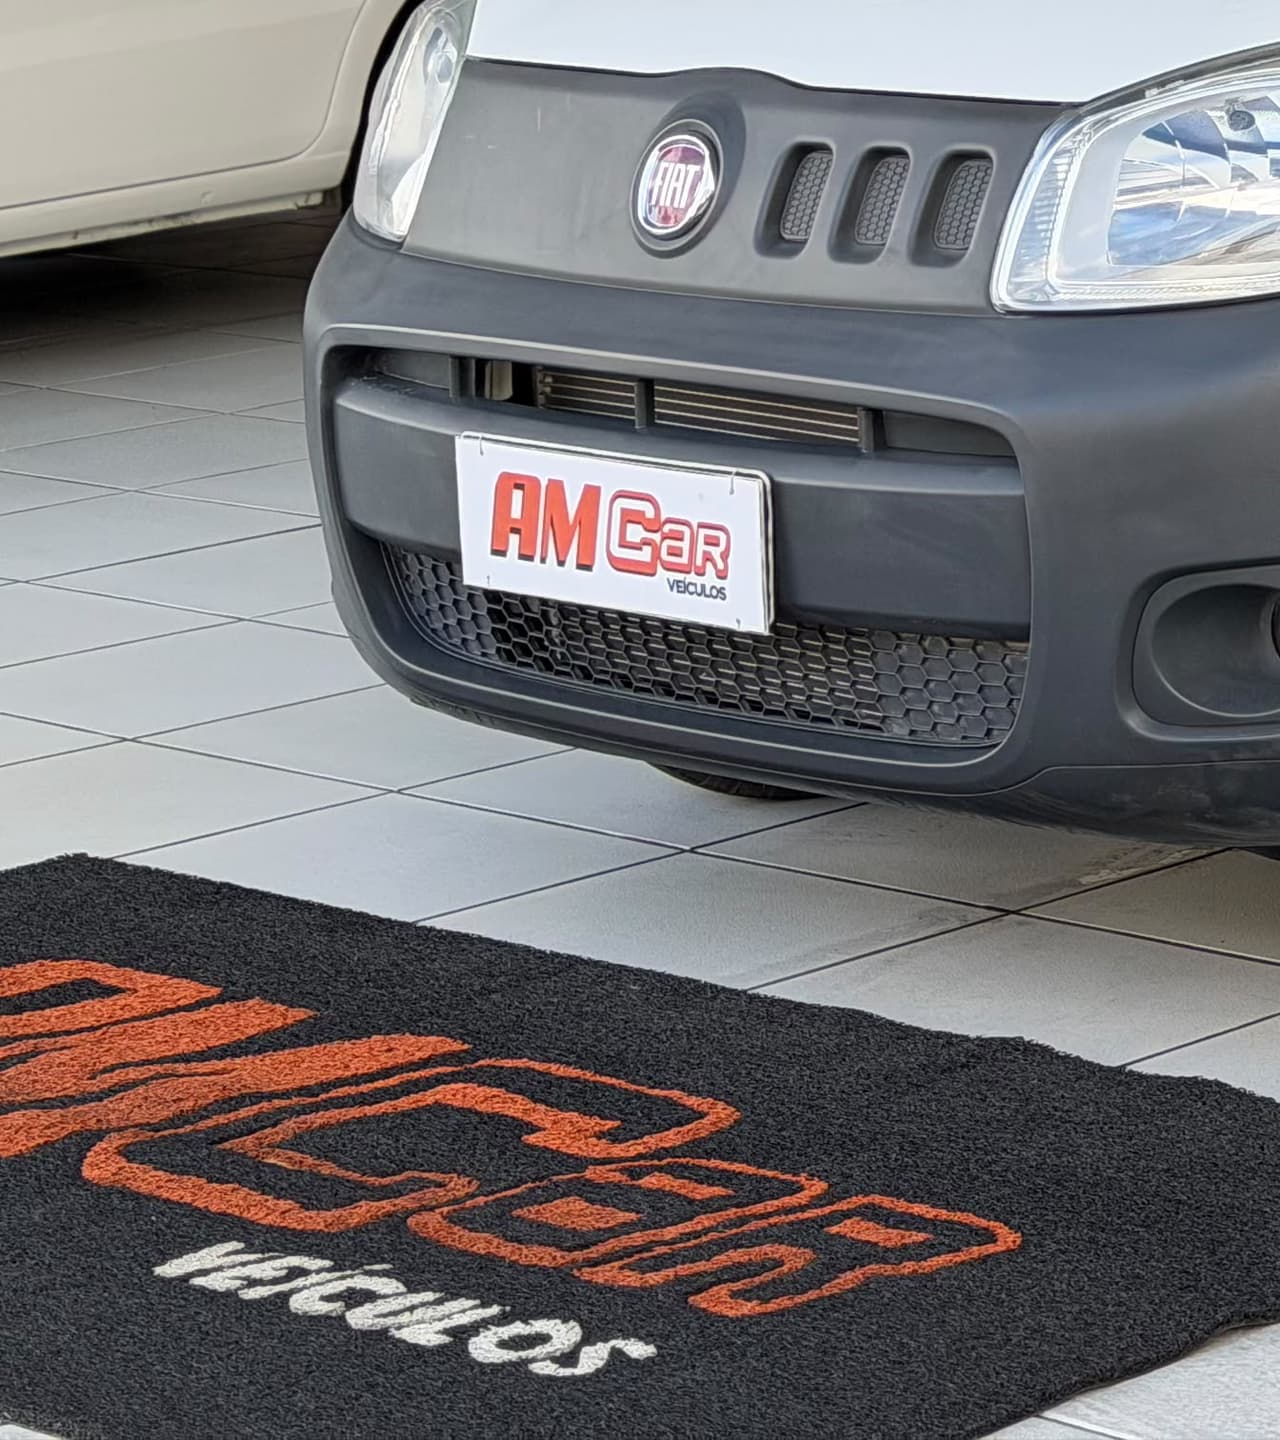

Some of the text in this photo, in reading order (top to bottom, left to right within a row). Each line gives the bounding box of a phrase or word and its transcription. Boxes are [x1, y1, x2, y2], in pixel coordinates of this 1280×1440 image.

[650, 161, 702, 210] FIAT
[666, 575, 728, 602] VEÍCULOS
[152, 1240, 659, 1377] VEÍCULOS
